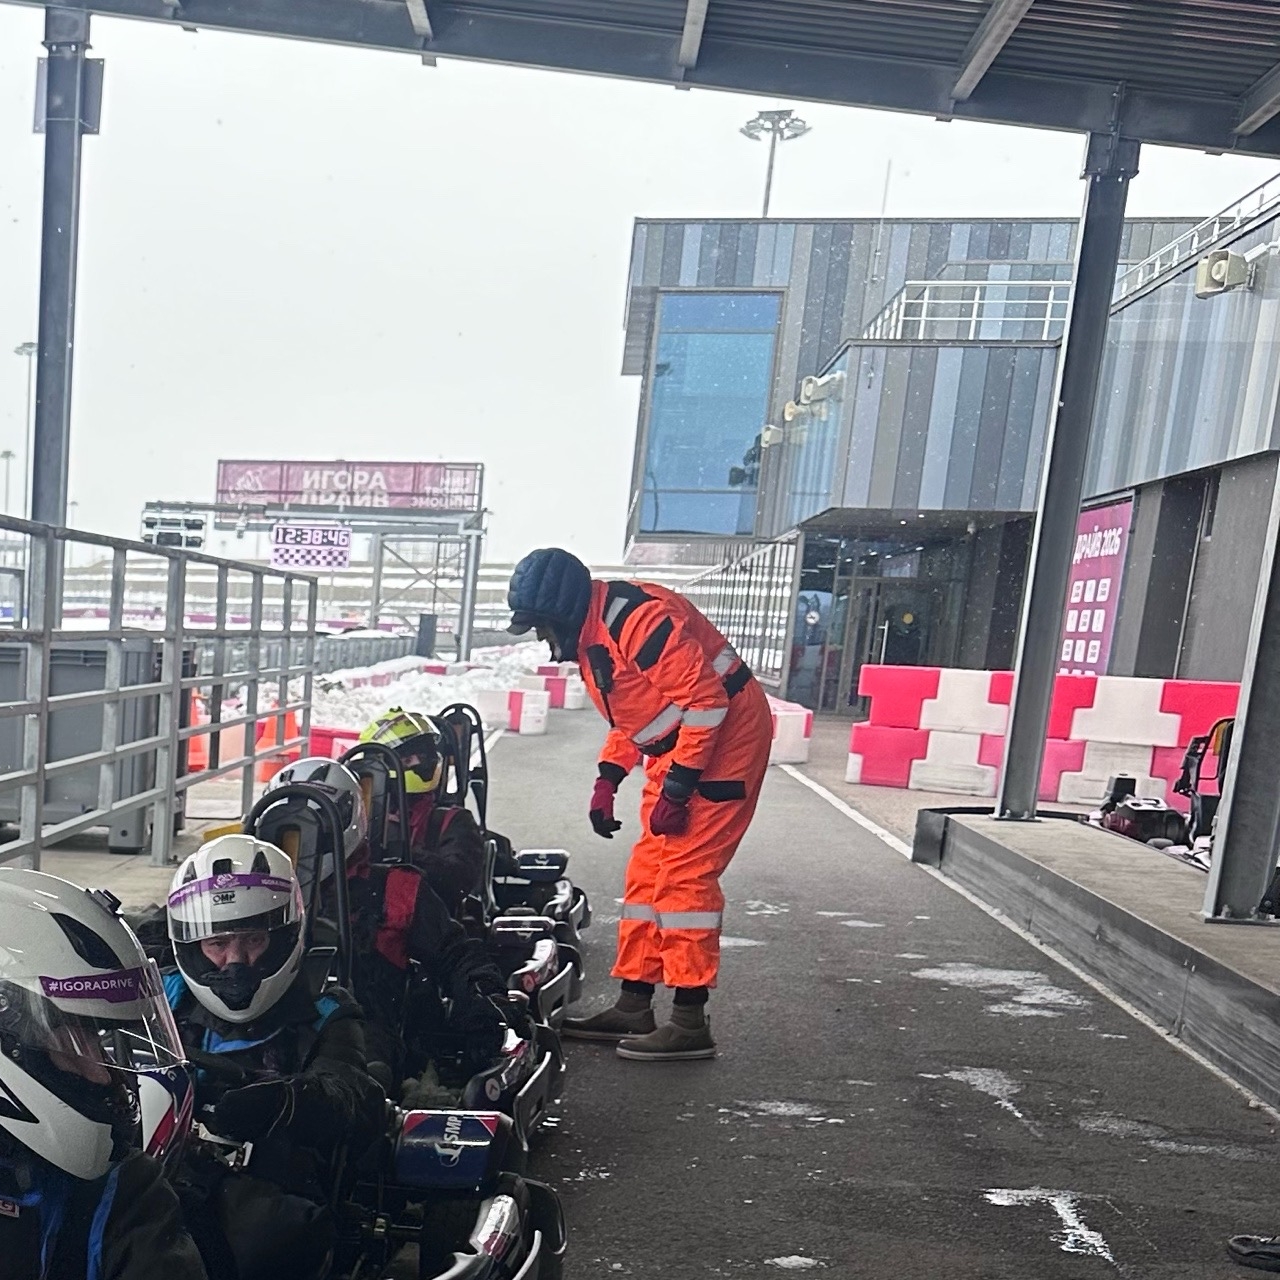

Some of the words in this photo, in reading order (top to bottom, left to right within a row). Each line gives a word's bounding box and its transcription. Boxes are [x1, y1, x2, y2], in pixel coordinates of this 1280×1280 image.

[302, 470, 387, 490] ИГОРА
[277, 528, 348, 546] 12:38:46
[1100, 527, 1123, 556] 2026
[213, 893, 236, 903] OMP
[49, 978, 133, 991] #IGORADRIVE
[443, 1116, 462, 1142] SMP
